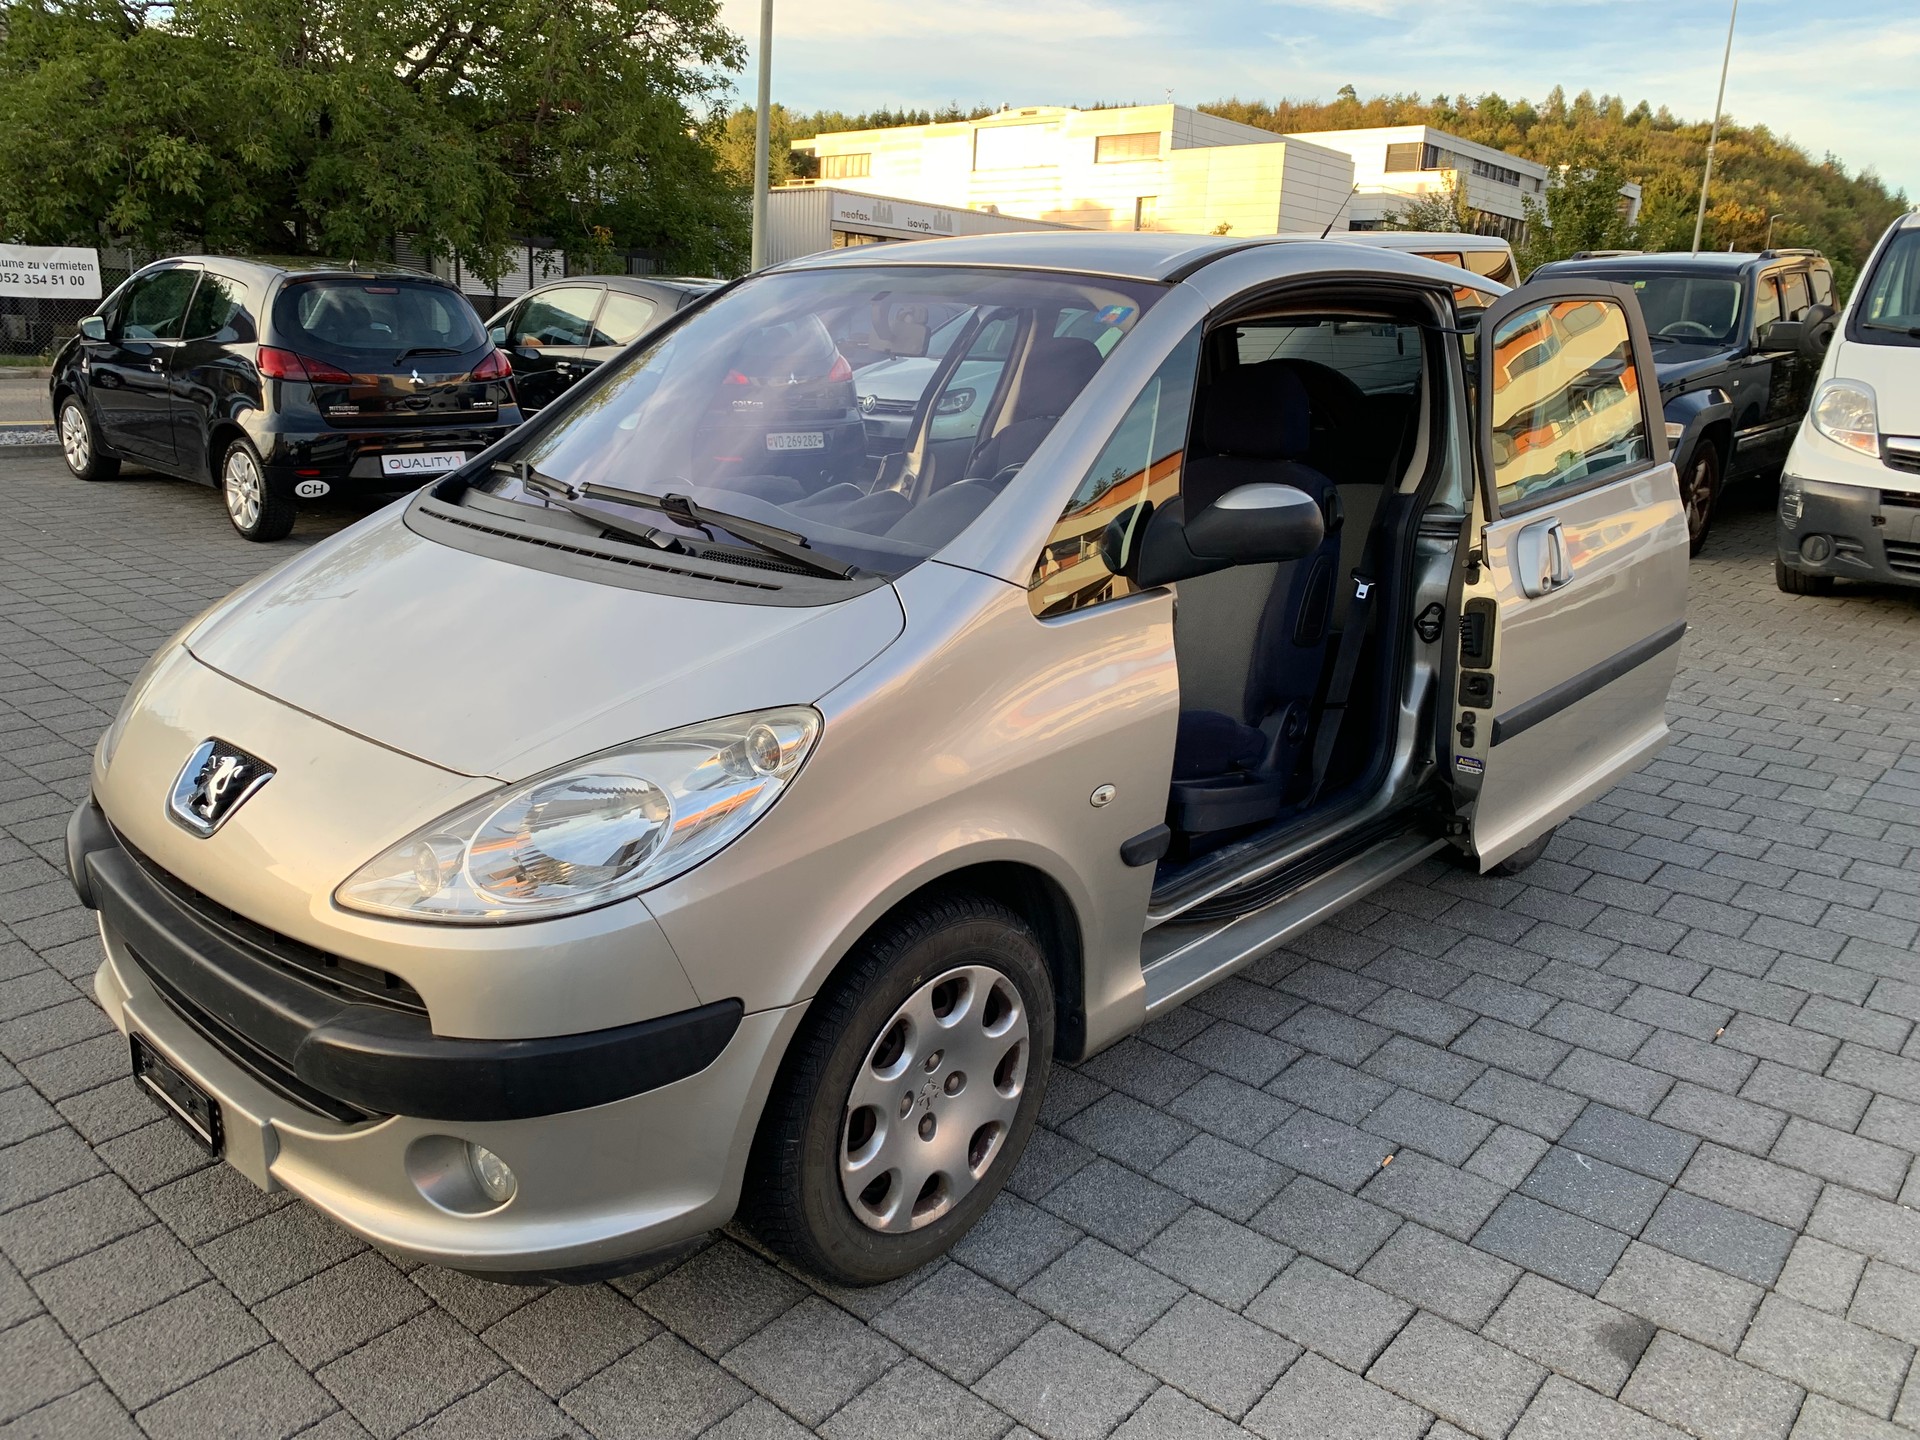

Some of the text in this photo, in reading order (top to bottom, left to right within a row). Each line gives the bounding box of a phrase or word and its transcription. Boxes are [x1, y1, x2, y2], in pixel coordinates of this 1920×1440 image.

[0, 259, 94, 271] ume zu vermieten
[24, 273, 47, 285] 354
[51, 275, 65, 285] 51
[69, 275, 85, 286] 00
[301, 484, 324, 495] CH
